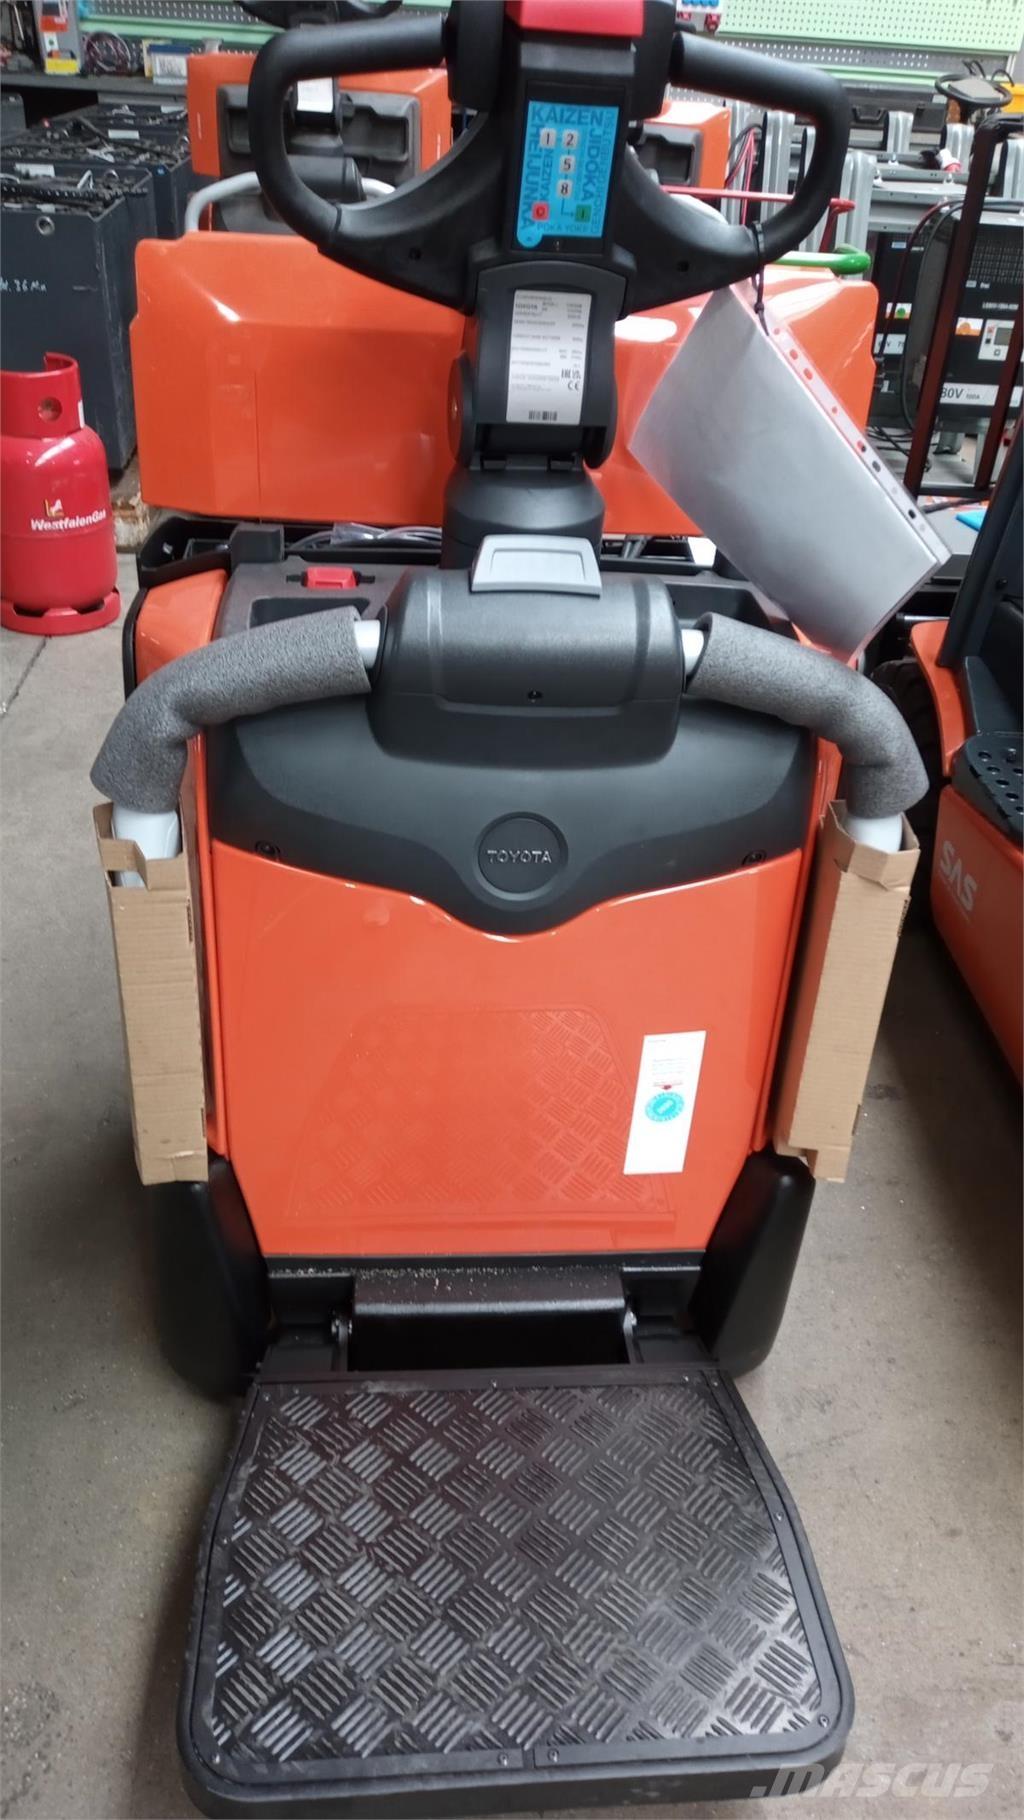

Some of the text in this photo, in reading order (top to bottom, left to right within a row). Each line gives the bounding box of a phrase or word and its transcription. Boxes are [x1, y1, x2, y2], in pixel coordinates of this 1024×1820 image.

[531, 105, 604, 126] KAIZEN
[566, 133, 574, 147] 2
[563, 157, 572, 171] 5
[582, 128, 602, 201] JIDOKA
[521, 123, 542, 230] HEIJUNKA
[560, 183, 569, 195] 8
[487, 849, 552, 864] TOYOTA
[940, 840, 977, 911] SAS
